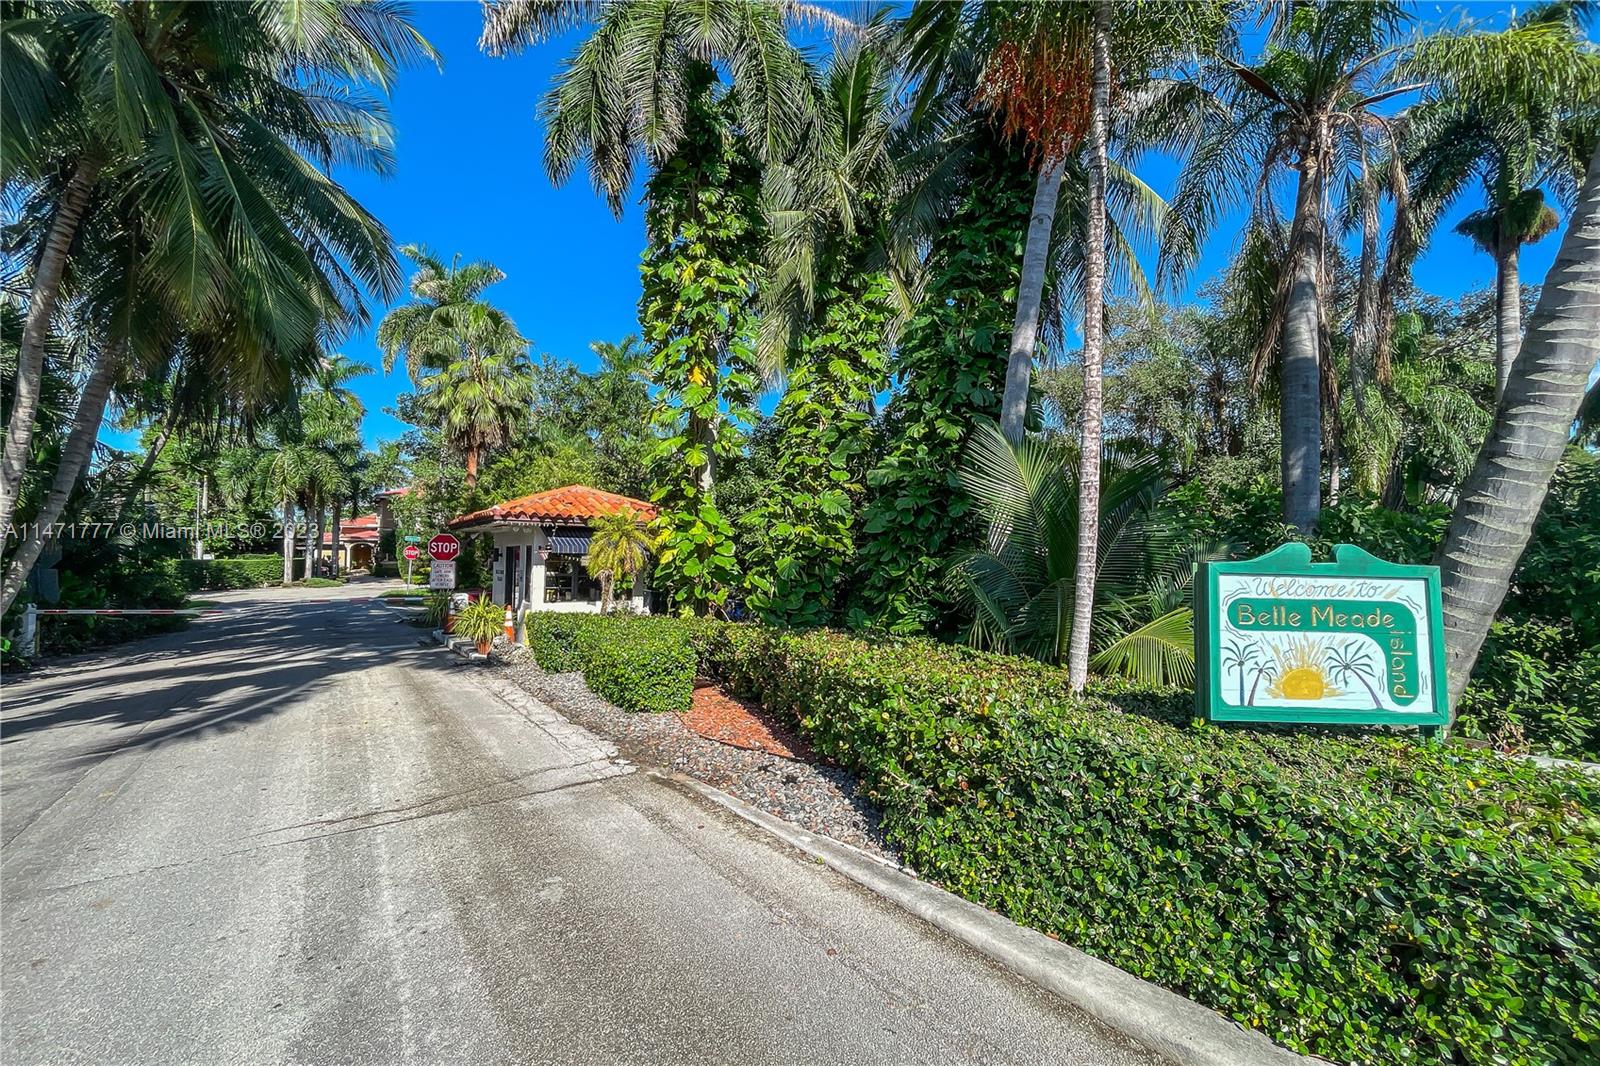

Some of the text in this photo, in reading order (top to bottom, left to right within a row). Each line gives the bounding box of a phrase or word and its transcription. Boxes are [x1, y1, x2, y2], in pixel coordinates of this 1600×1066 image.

[430, 542, 458, 553] STOP
[1253, 577, 1383, 598] Welcome to
[1237, 604, 1395, 628] Belle Meade
